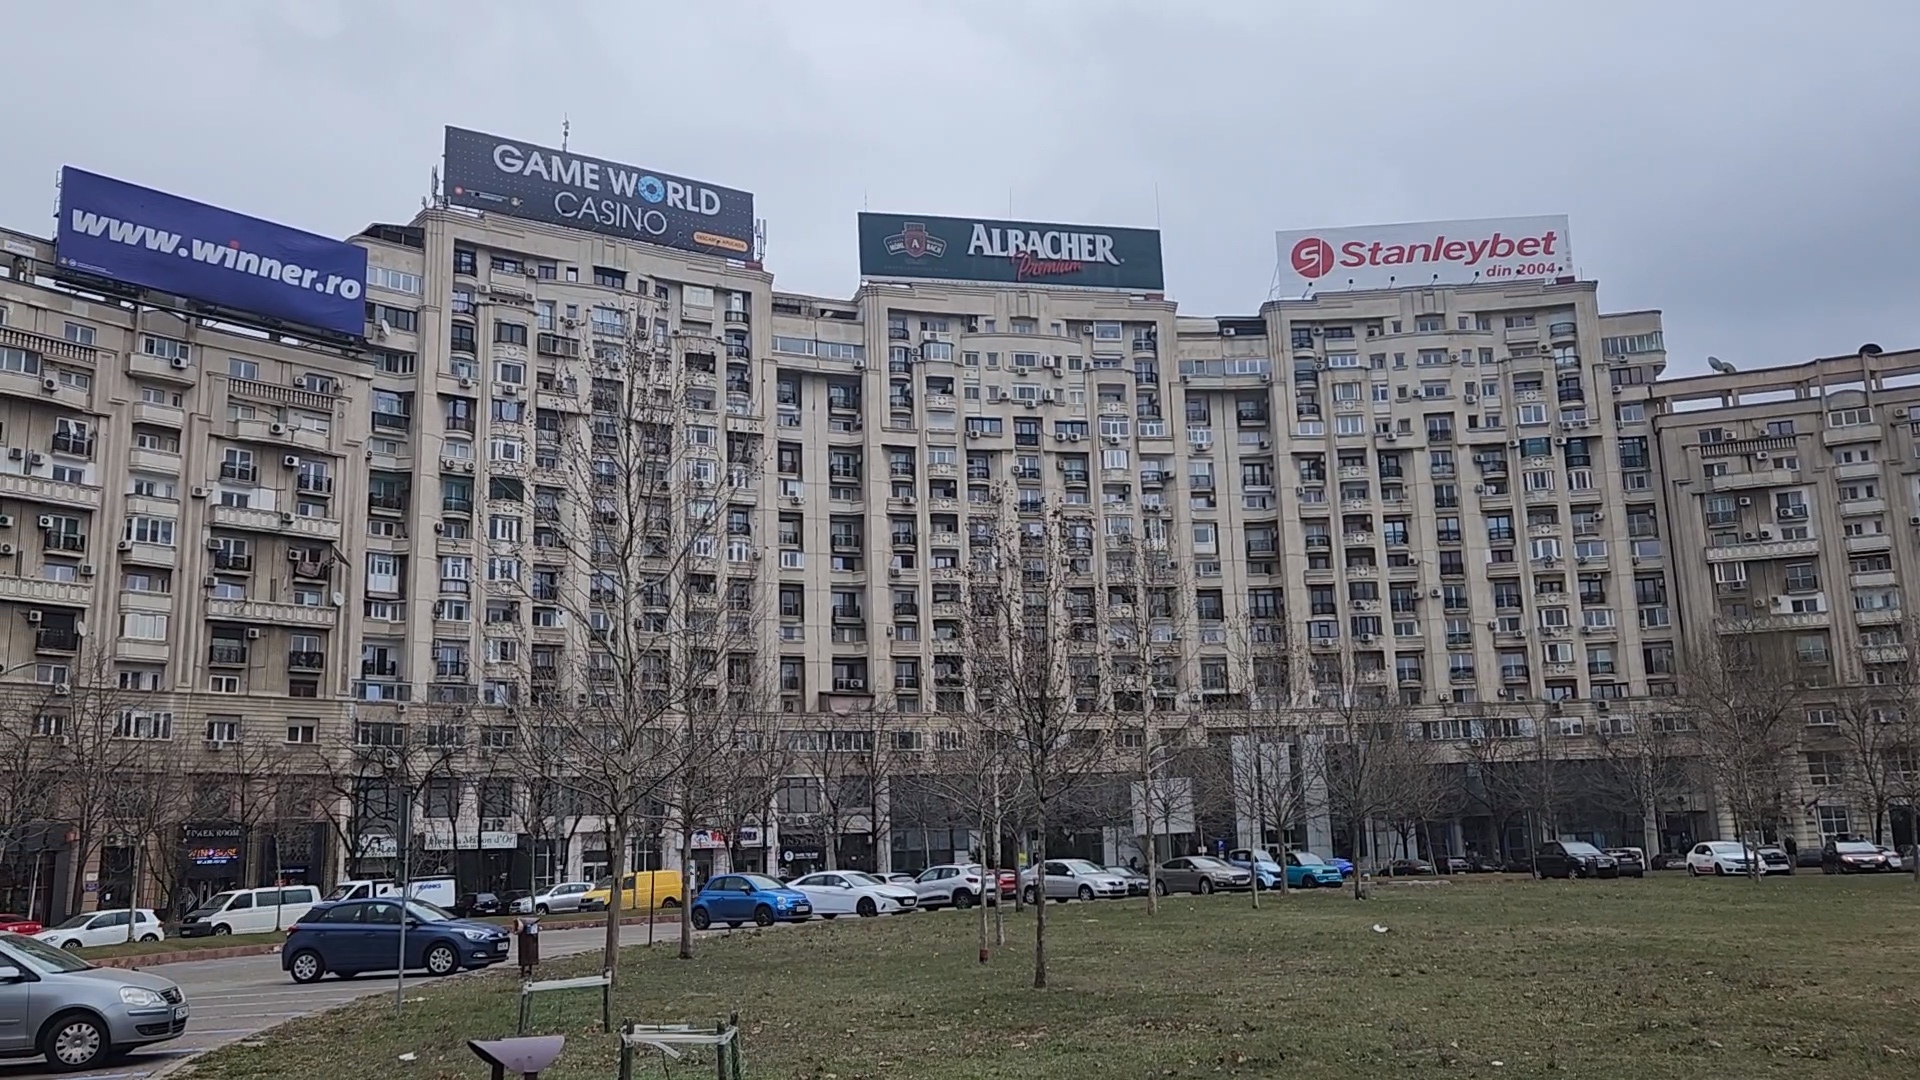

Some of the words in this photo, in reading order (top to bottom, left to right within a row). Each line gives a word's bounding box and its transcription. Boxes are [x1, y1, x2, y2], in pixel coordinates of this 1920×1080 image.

[493, 144, 600, 191] GAME
[607, 167, 721, 215] WORLD
[554, 191, 667, 235] CASINO
[71, 208, 361, 299] www.winner.ro
[966, 223, 1120, 265] ALBACHER
[1338, 231, 1557, 267] Stanleybet
[1011, 251, 1083, 281] Premium
[1486, 264, 1512, 278] din
[1518, 262, 1556, 276] 2004
